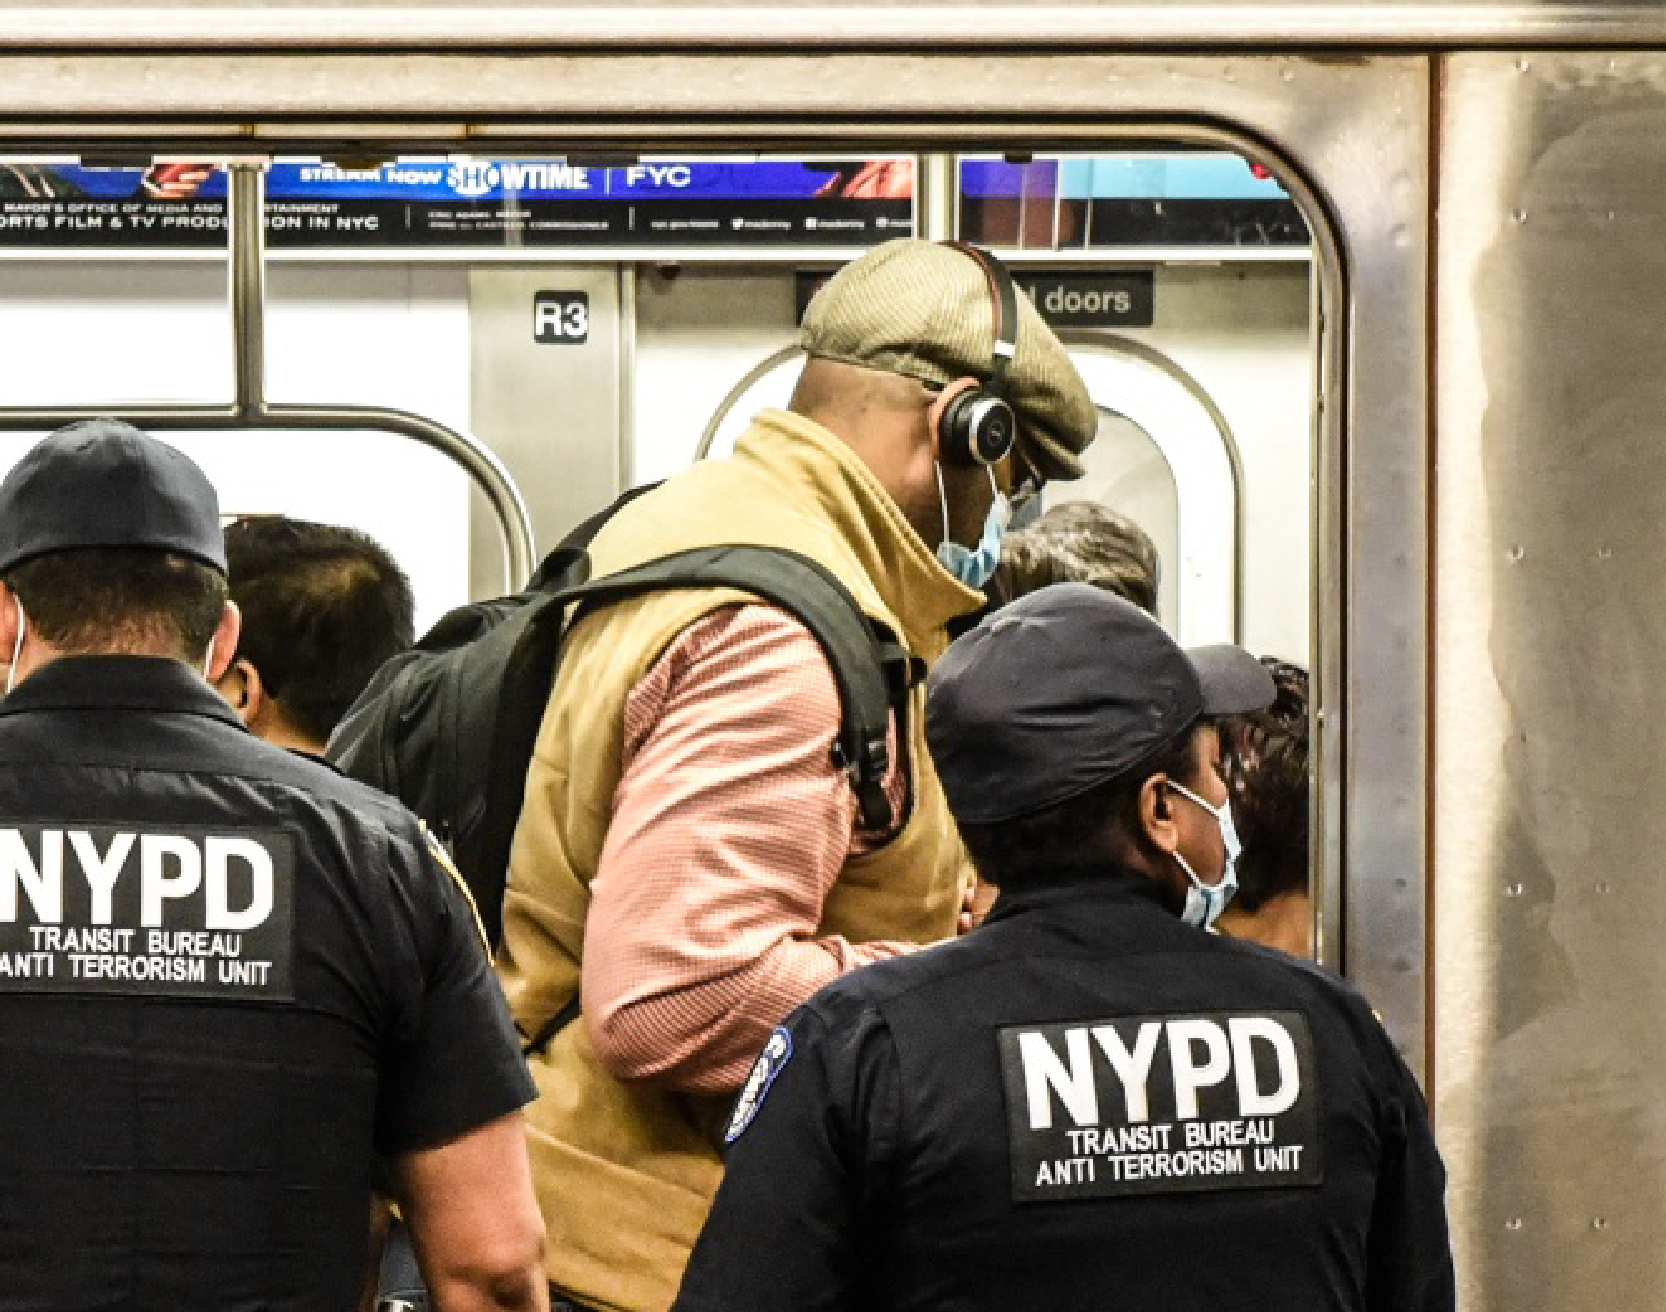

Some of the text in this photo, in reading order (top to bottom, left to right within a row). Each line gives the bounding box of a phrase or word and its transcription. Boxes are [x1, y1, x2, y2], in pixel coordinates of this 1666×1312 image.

[388, 169, 441, 184] NOW
[447, 162, 589, 194] SHOWTIME
[627, 165, 691, 187] FYC
[54, 214, 101, 229] FILM
[109, 215, 121, 229] &
[131, 215, 154, 229] TV
[309, 216, 330, 230] IN
[336, 216, 379, 230] NYC
[1045, 285, 1131, 313] doors
[535, 302, 588, 337] R3
[30, 927, 243, 958] TRANSIT BUREAU
[68, 954, 206, 983] TERRORISM
[219, 960, 273, 986] UNIT
[1019, 1016, 1301, 1132] NYPD
[1066, 1119, 1274, 1157] TRANSIT BUREAU
[1036, 1145, 1303, 1187] ANTI TERRORISM UNIT
